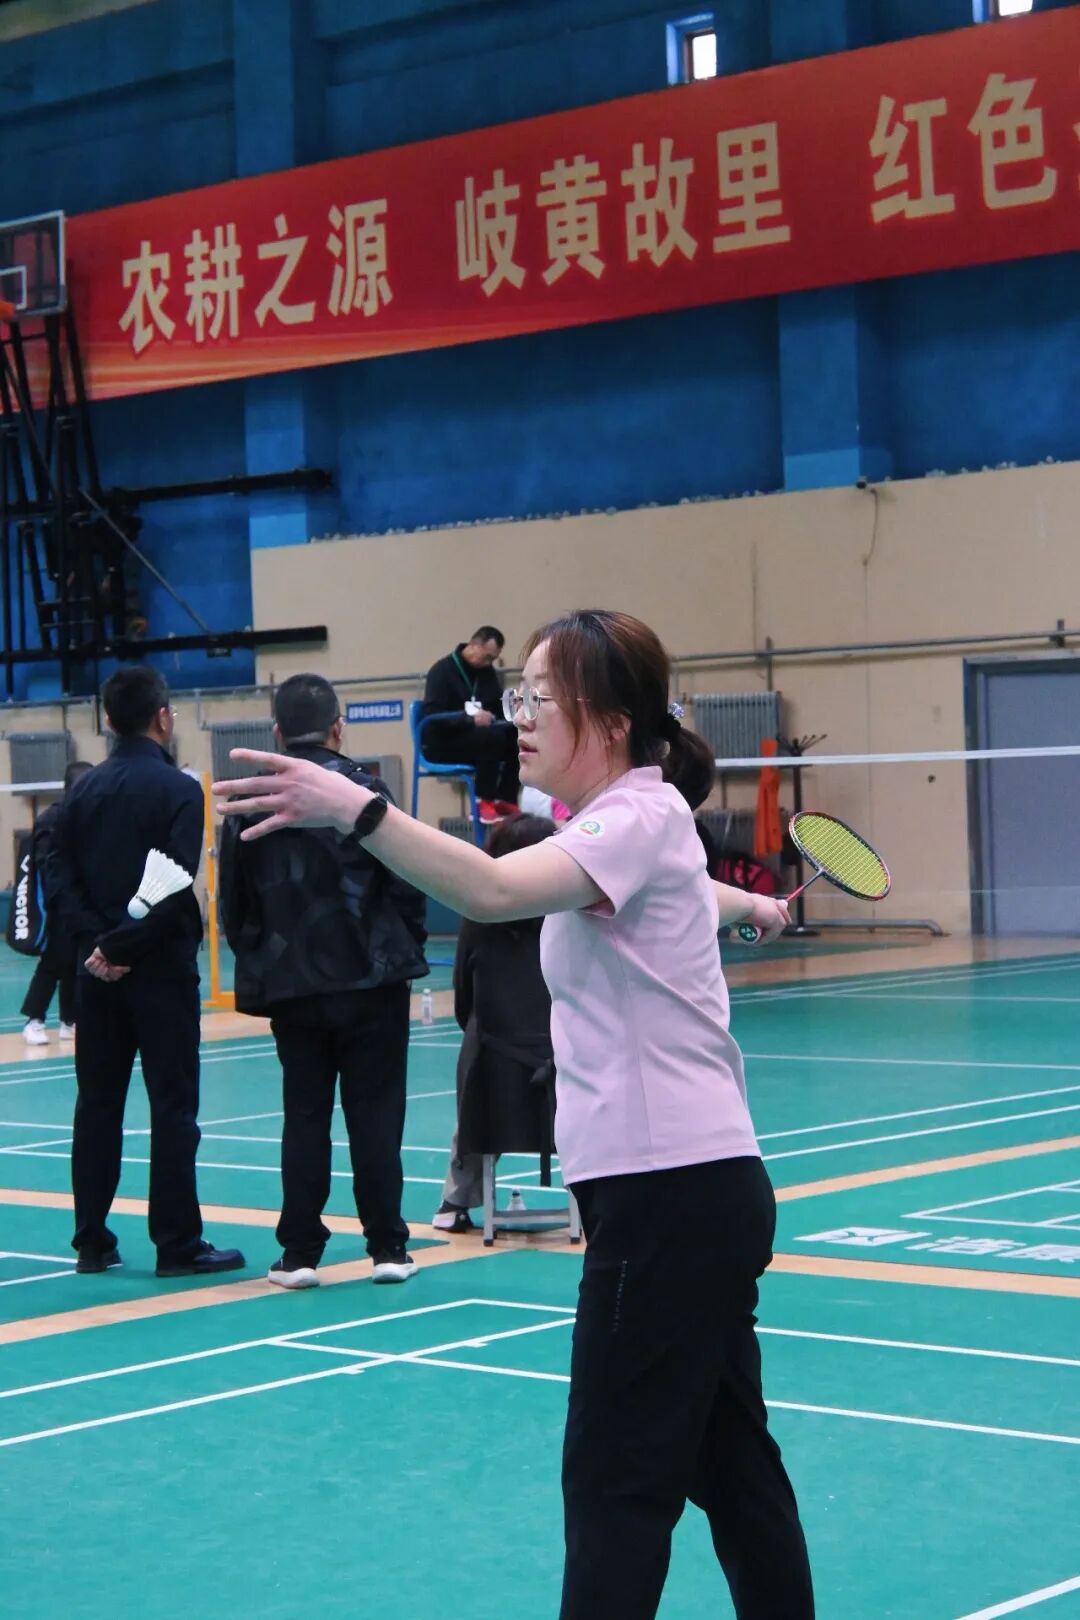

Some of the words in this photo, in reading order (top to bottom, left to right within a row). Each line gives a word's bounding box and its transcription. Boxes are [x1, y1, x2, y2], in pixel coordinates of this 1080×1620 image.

[118, 198, 393, 355] 农耕之源
[455, 122, 791, 297] 岐黄故里
[868, 72, 1080, 224] 红色
[15, 873, 29, 940] VICTOR
